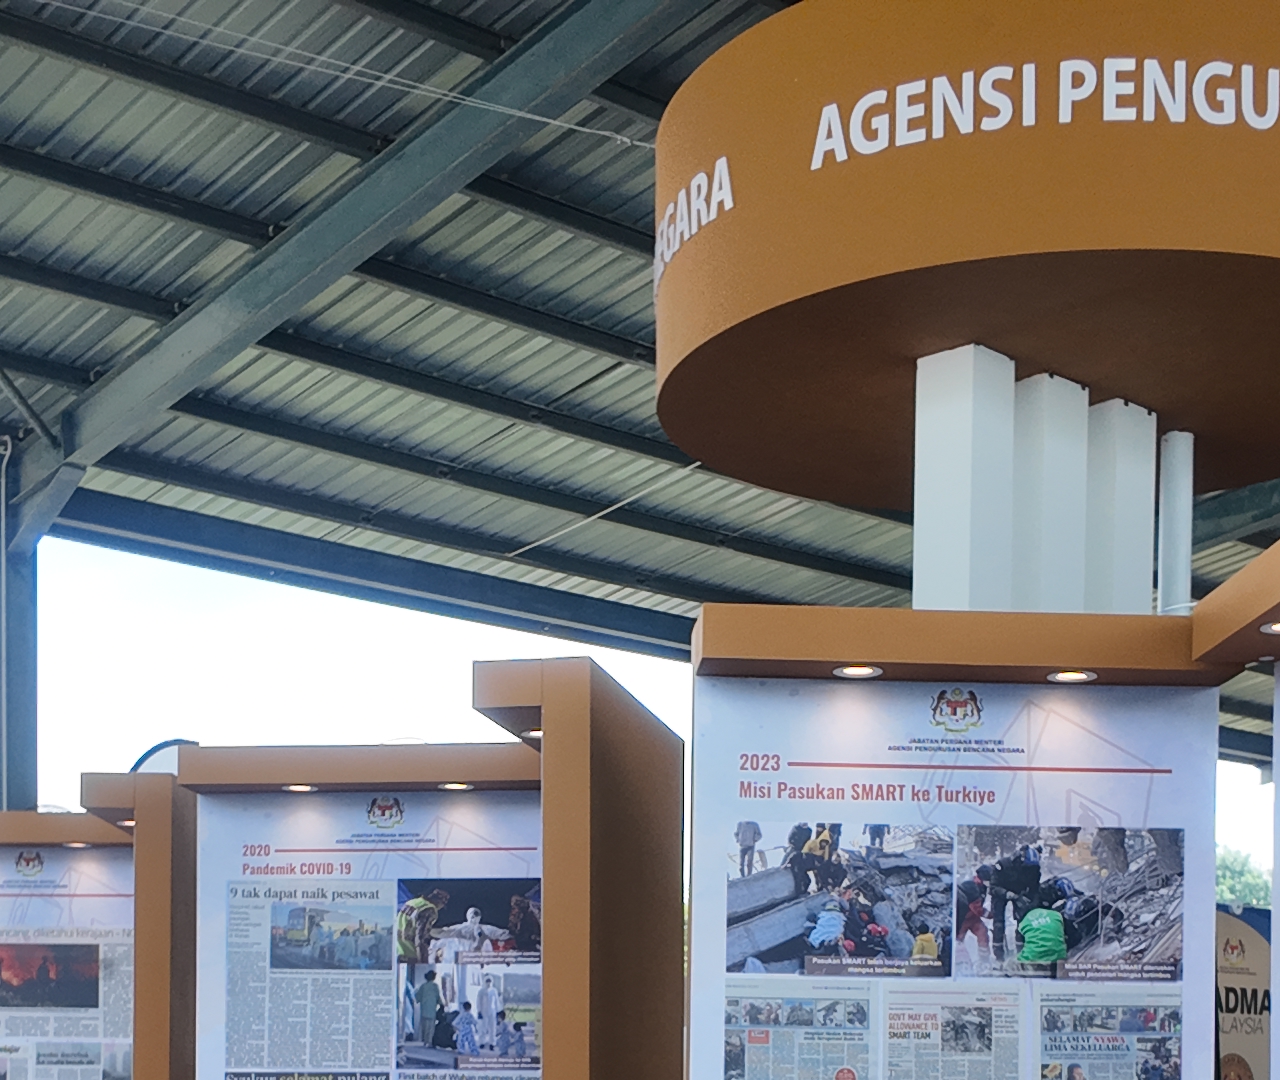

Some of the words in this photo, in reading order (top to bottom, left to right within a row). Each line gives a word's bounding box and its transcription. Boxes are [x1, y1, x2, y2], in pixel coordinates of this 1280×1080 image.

[811, 63, 1036, 171] AGENSI
[654, 155, 734, 285] EGARA
[739, 754, 780, 772] 2023
[739, 781, 772, 799] Misi
[777, 782, 845, 801] Pasukan
[851, 783, 906, 802] SMART
[911, 784, 930, 802] ke
[936, 785, 996, 805] Turkiye
[242, 845, 270, 857] 2020
[242, 863, 296, 876] Pandemik
[300, 863, 352, 876] COVID-19
[230, 887, 238, 898] 9
[242, 888, 260, 898] tak
[264, 887, 297, 900] dapat
[302, 888, 328, 899] naik
[332, 889, 380, 901] pesawat
[1217, 986, 1271, 1016] DMA
[908, 1013, 922, 1021] MAY
[888, 1022, 928, 1030] ALLOWANCE
[1220, 1016, 1264, 1035] LAYSIA
[888, 1032, 910, 1040] SMART
[913, 1032, 930, 1040] TEAM
[1048, 1036, 1090, 1044] SELAMAT
[1094, 1036, 1126, 1044] NYAWA
[1044, 1044, 1068, 1052] LIMA
